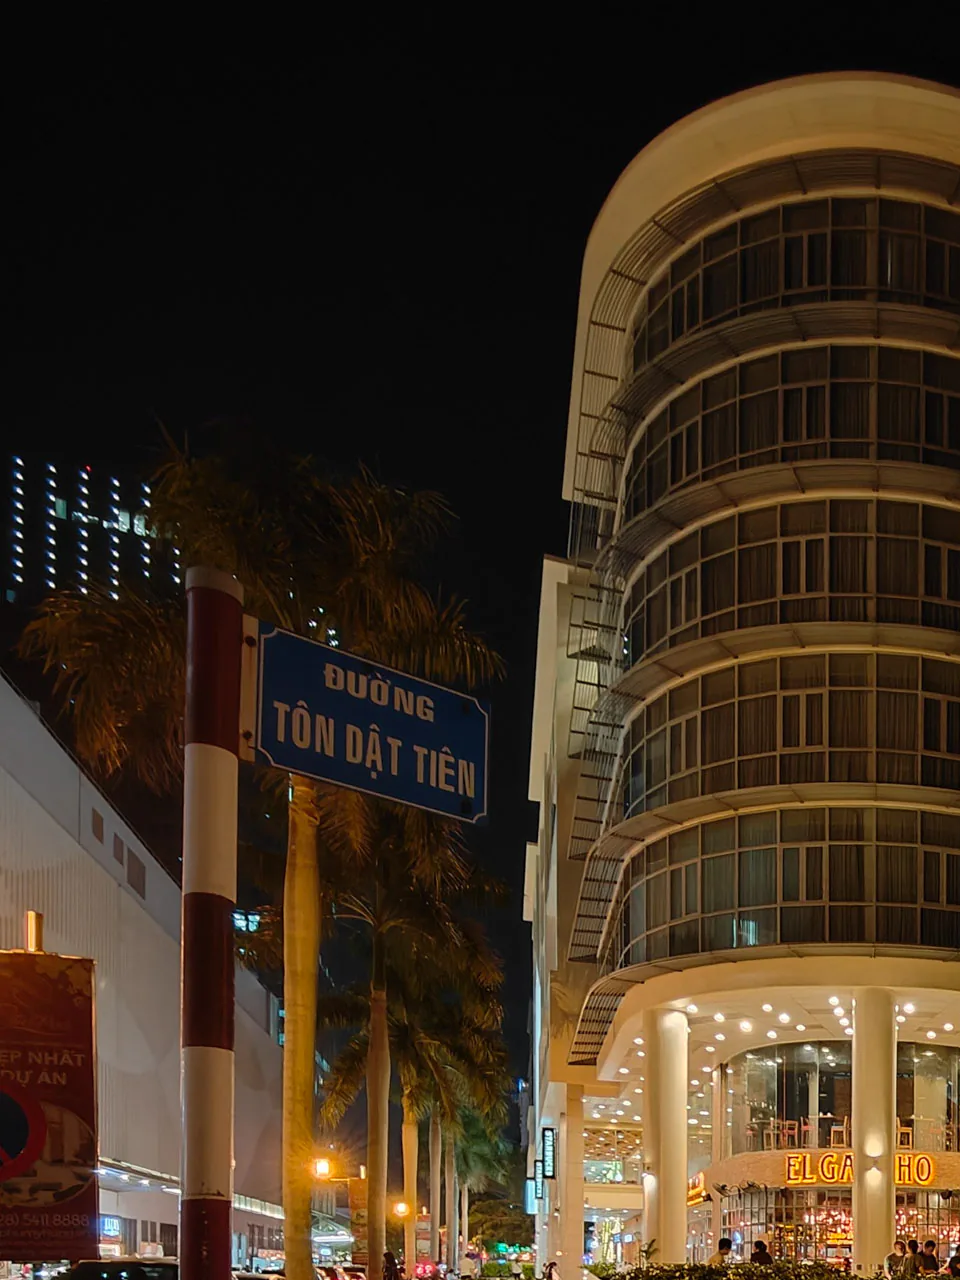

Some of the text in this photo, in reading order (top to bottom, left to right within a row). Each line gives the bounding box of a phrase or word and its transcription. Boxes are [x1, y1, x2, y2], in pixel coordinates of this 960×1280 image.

[273, 700, 476, 799] TÔN DẬT TIÊN
[786, 1152, 934, 1186] EL GAHO
